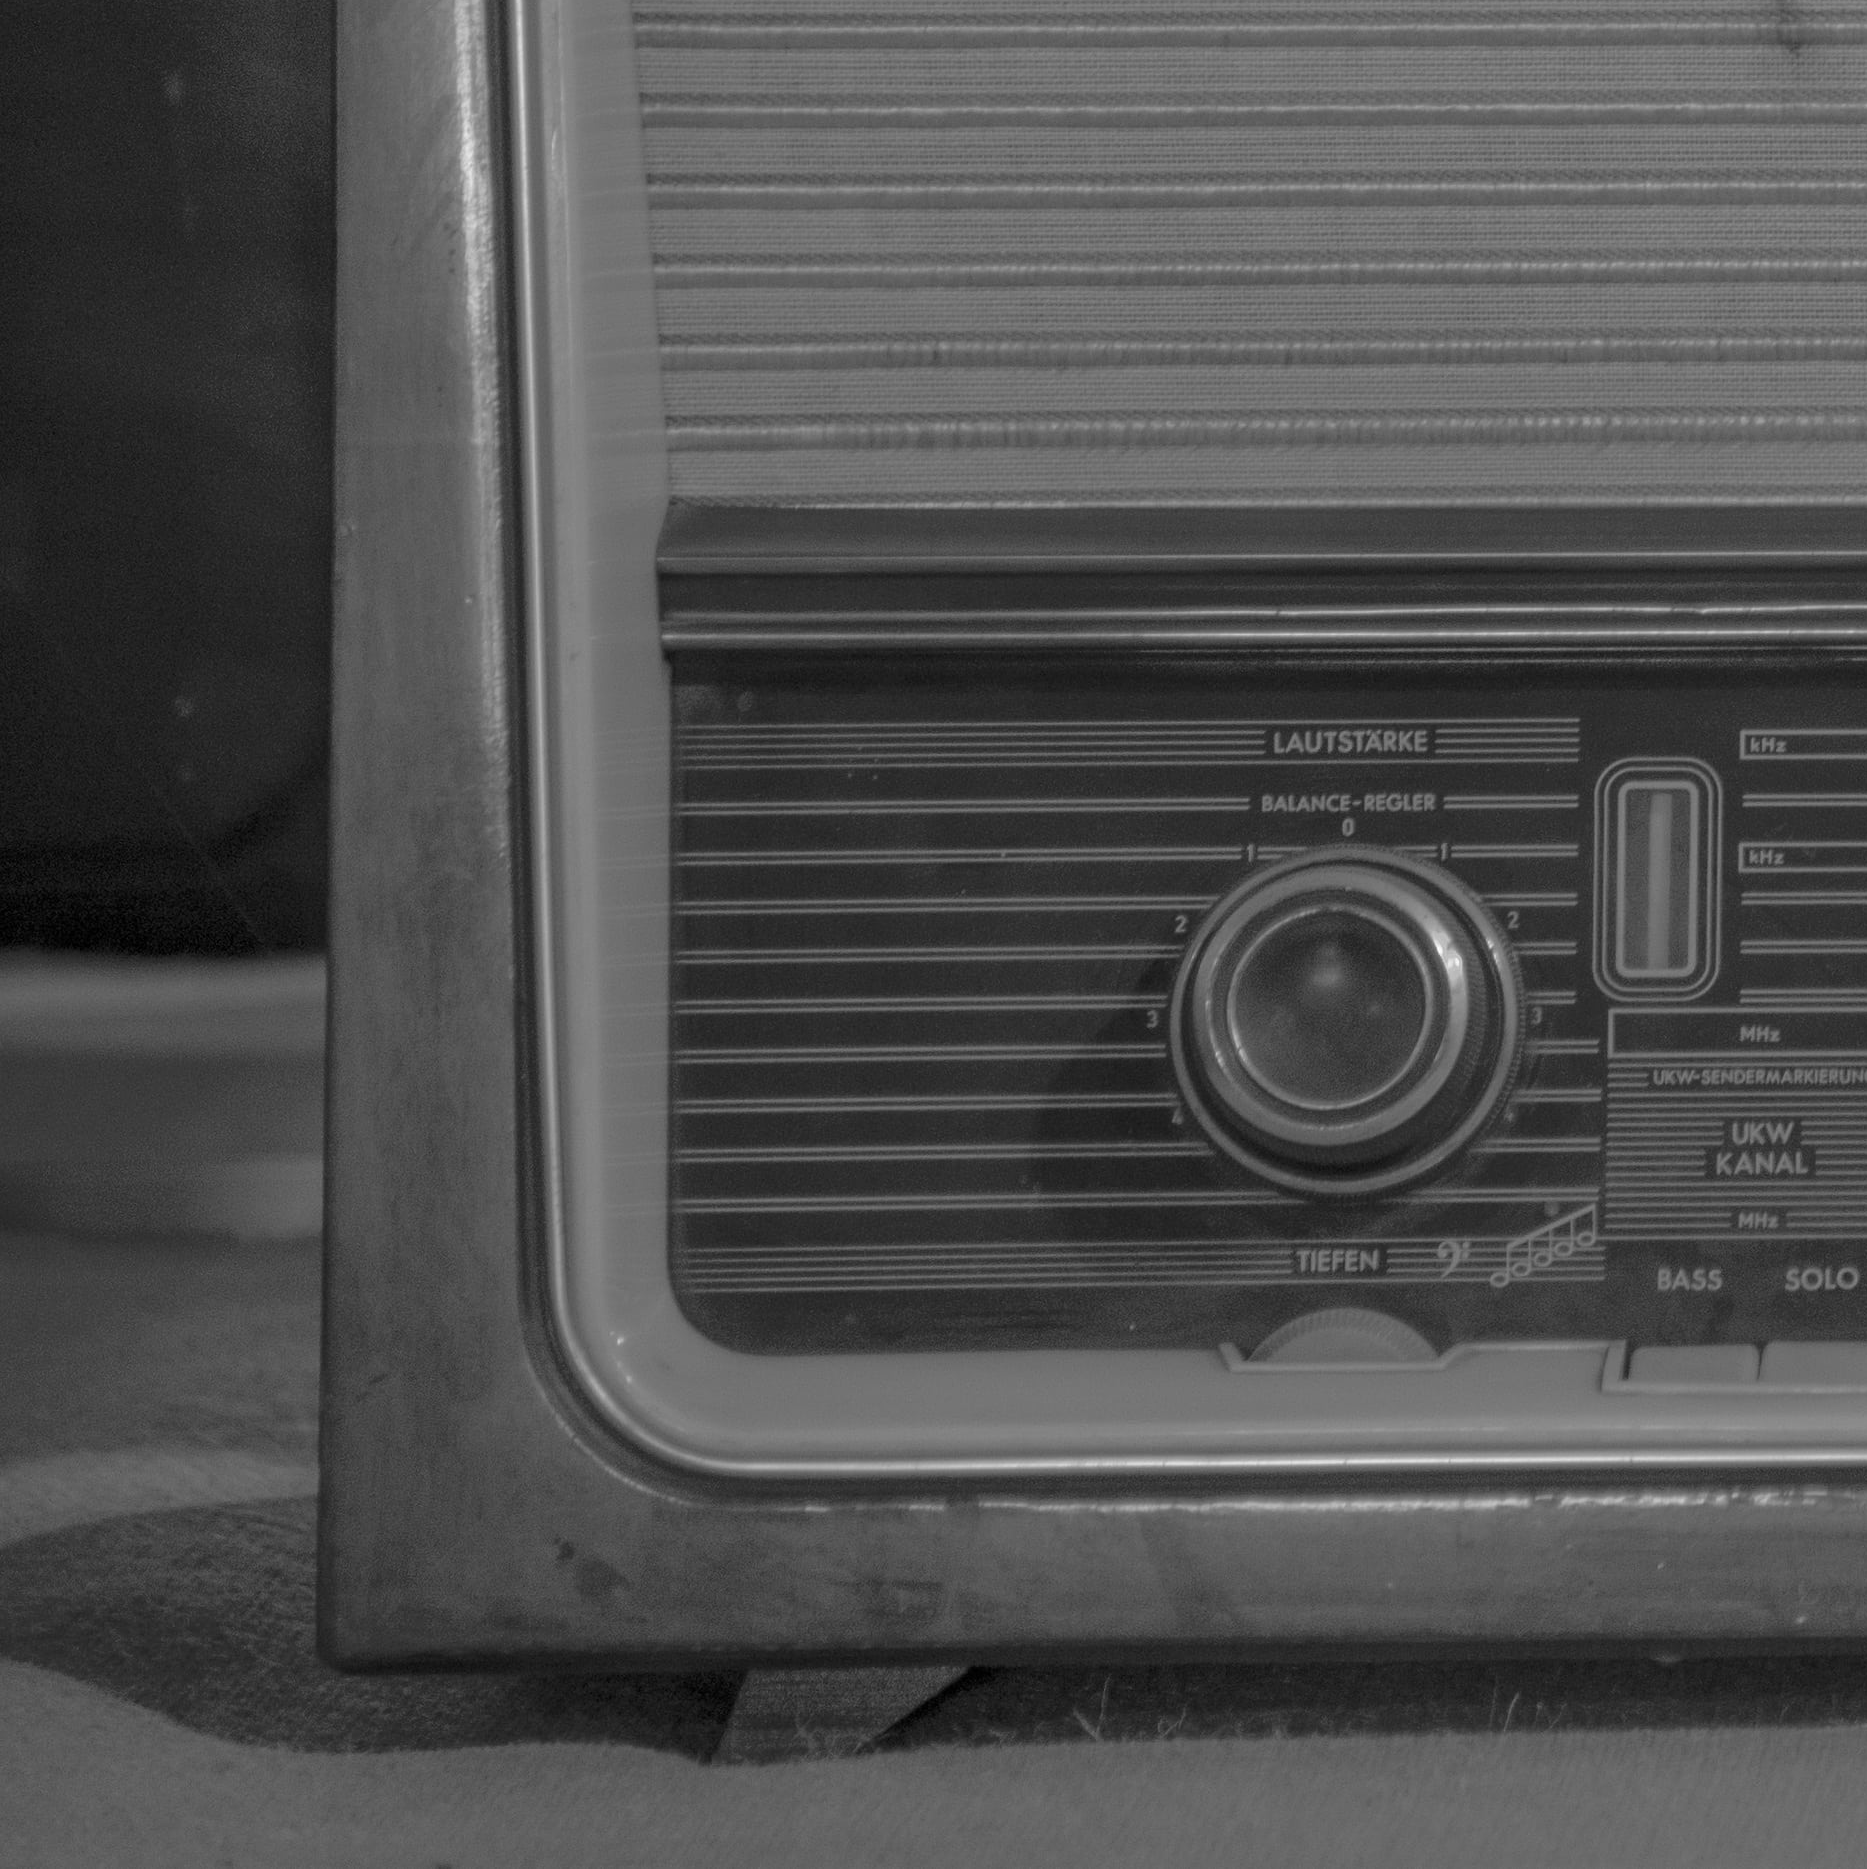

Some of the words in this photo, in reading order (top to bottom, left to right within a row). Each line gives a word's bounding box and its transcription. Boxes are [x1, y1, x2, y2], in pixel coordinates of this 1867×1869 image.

[1273, 729, 1429, 754] LAUTSTÄRKE
[1749, 737, 1787, 754] kHz
[1261, 794, 1437, 813] BALANCE-REGLER
[1748, 850, 1785, 867] kHz
[1174, 914, 1189, 934] 2
[1507, 911, 1520, 930] 2
[1740, 1026, 1781, 1044] MHz
[1732, 1121, 1795, 1145] UKW
[1715, 1151, 1809, 1177] KANAL
[1738, 1211, 1780, 1229] MHz
[1300, 1248, 1379, 1274] TIEFEN
[1657, 1268, 1723, 1291] BASS
[1785, 1268, 1859, 1291] SOLO
